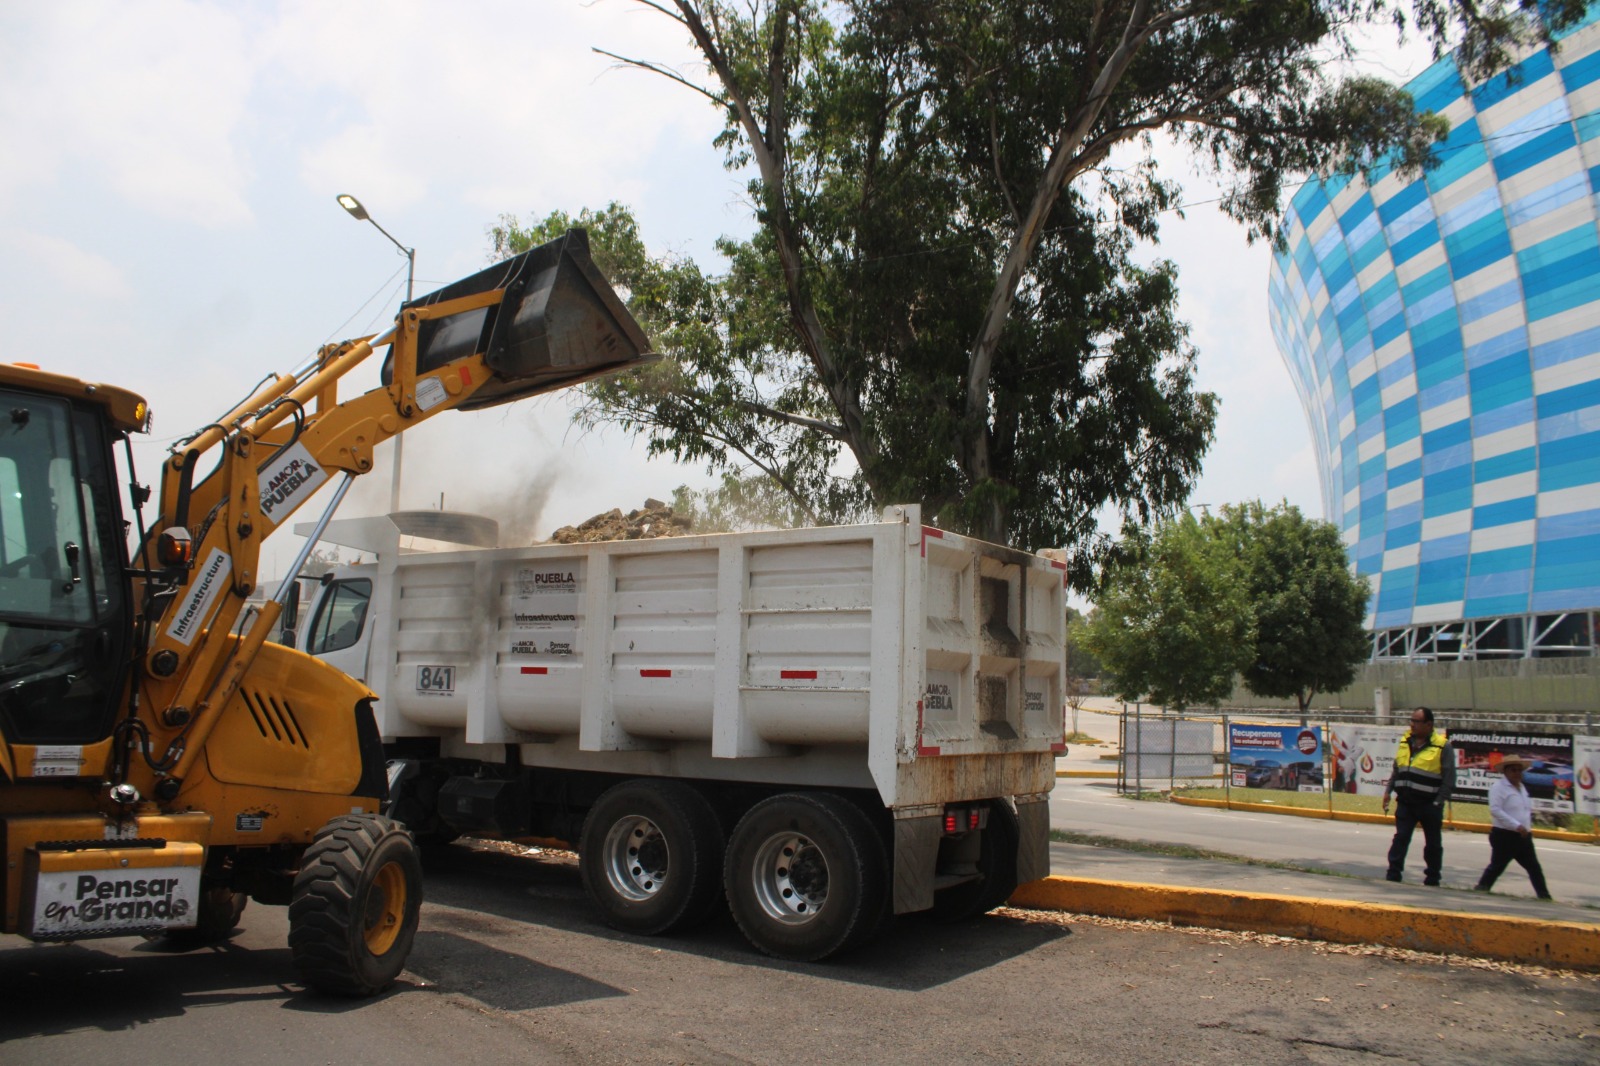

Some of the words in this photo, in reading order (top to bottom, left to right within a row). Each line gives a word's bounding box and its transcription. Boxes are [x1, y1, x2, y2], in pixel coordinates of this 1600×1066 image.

[260, 487, 272, 499] OR
[268, 459, 301, 491] AMOR
[261, 463, 319, 513] PUEBLA
[535, 572, 575, 584] PUEBLA
[173, 555, 225, 636] Infraestructura
[515, 613, 575, 621] Infraestructura
[421, 667, 451, 689] 841
[926, 684, 948, 695] AMOR
[925, 696, 953, 710] UEBLA
[1232, 729, 1282, 738] Recuperamos
[1516, 737, 1530, 745] EN
[1531, 737, 1570, 747] PUEBLA!
[76, 875, 178, 900] Pensar
[45, 901, 79, 922] en
[78, 894, 189, 922] Grande
